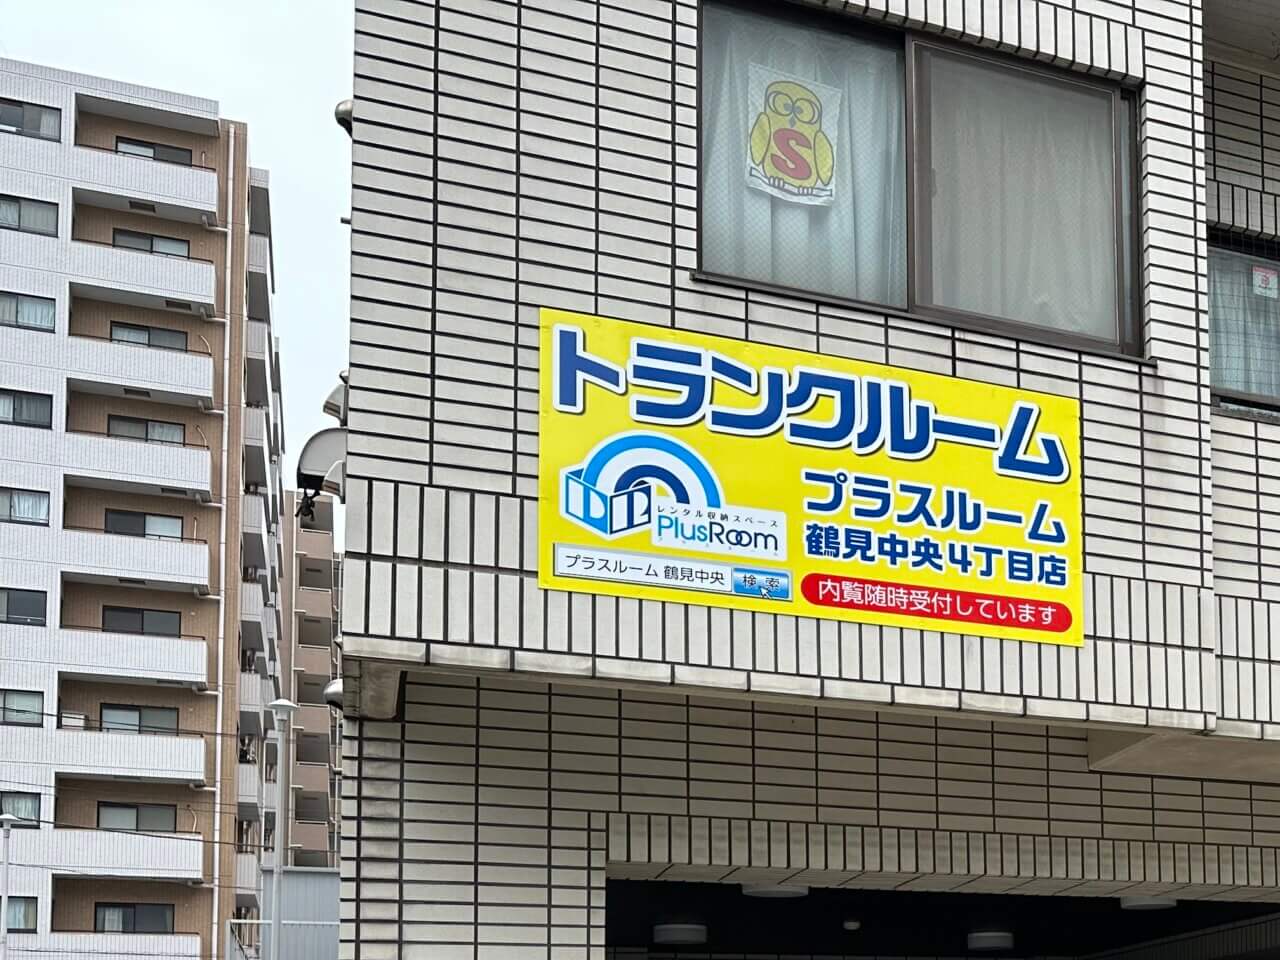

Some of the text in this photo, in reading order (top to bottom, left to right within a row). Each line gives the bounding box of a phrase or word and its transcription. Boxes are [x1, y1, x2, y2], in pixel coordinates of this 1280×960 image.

[557, 327, 1066, 478] トランクルーム
[657, 505, 778, 528] レンタル収納スペース
[804, 470, 1067, 544] プラスルーム
[658, 515, 778, 551] PlusRoom
[804, 523, 1067, 586] 鶴見中央4丁目店
[565, 554, 725, 585] プラスルーム 鶴見中央
[817, 581, 1057, 625] 内覧随時受付しています
